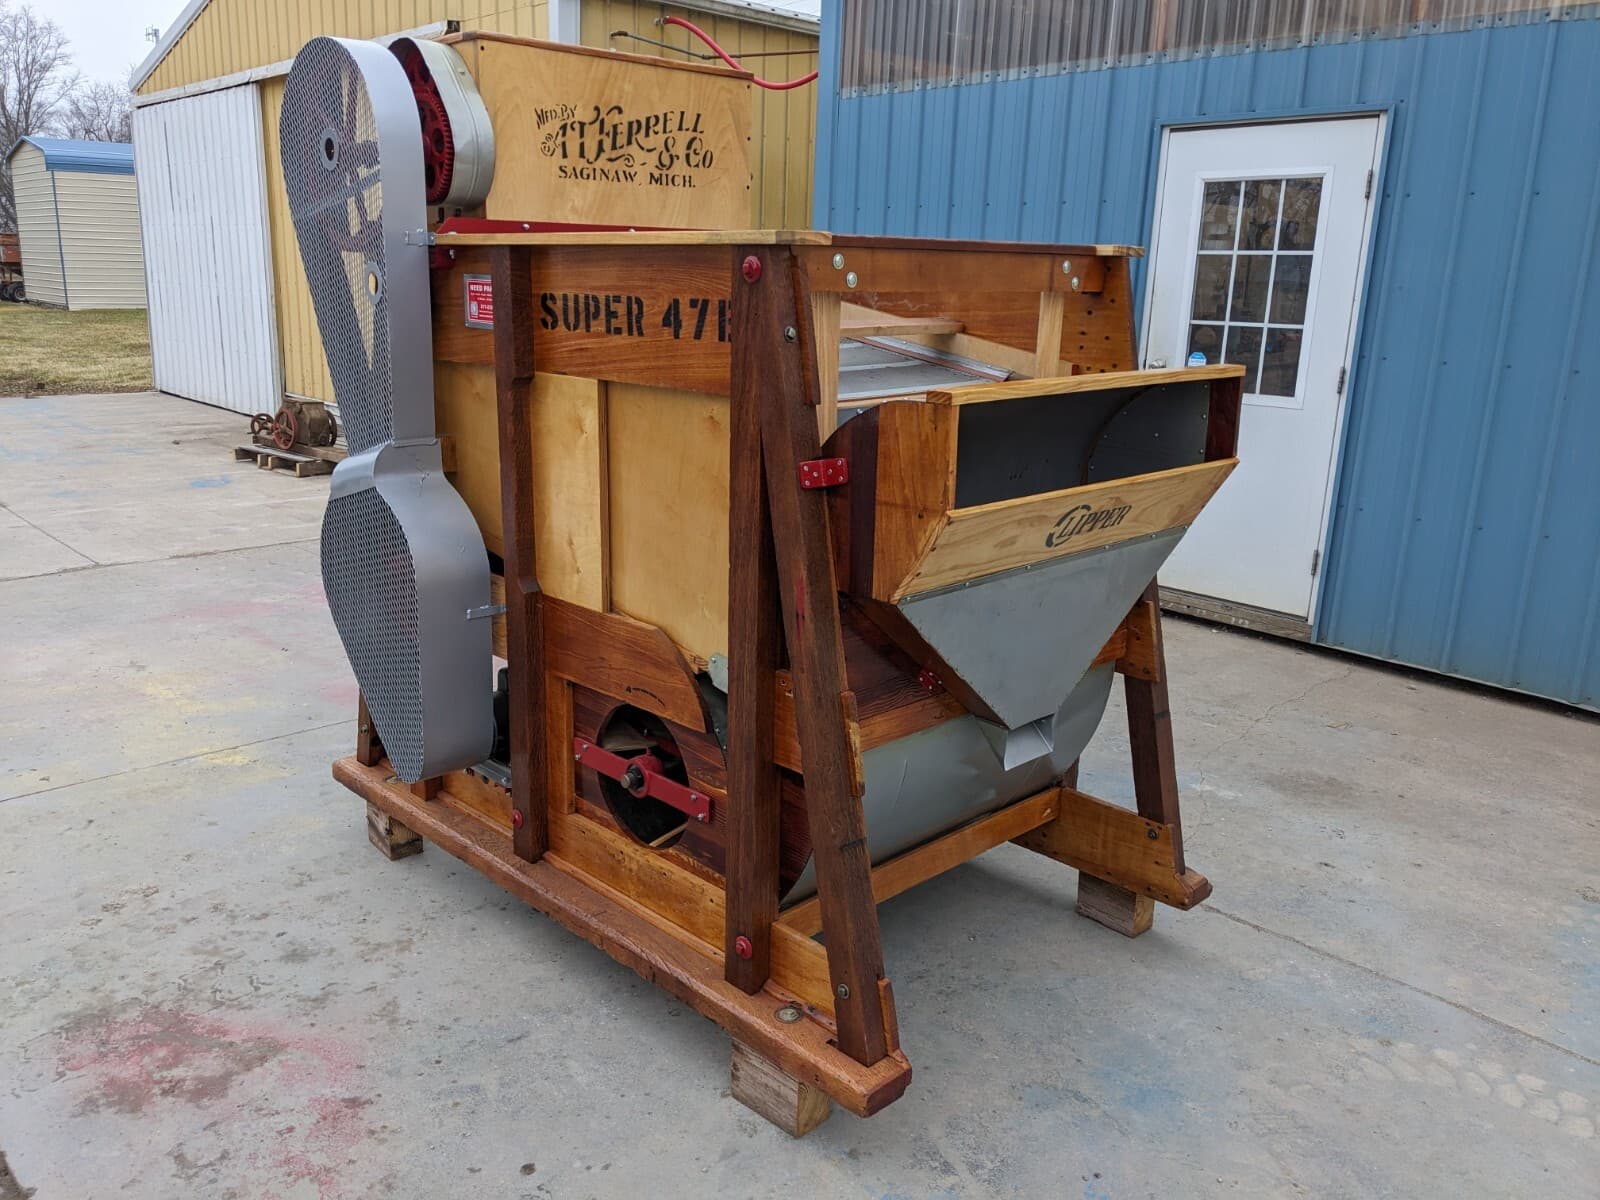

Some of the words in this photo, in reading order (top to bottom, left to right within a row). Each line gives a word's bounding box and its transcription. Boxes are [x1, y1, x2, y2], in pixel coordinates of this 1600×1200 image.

[586, 104, 705, 165] FERRELL
[655, 136, 680, 171] &
[649, 172, 697, 188] MICH.
[540, 292, 644, 337] SUPER
[1045, 504, 1132, 548] CLIPPER
